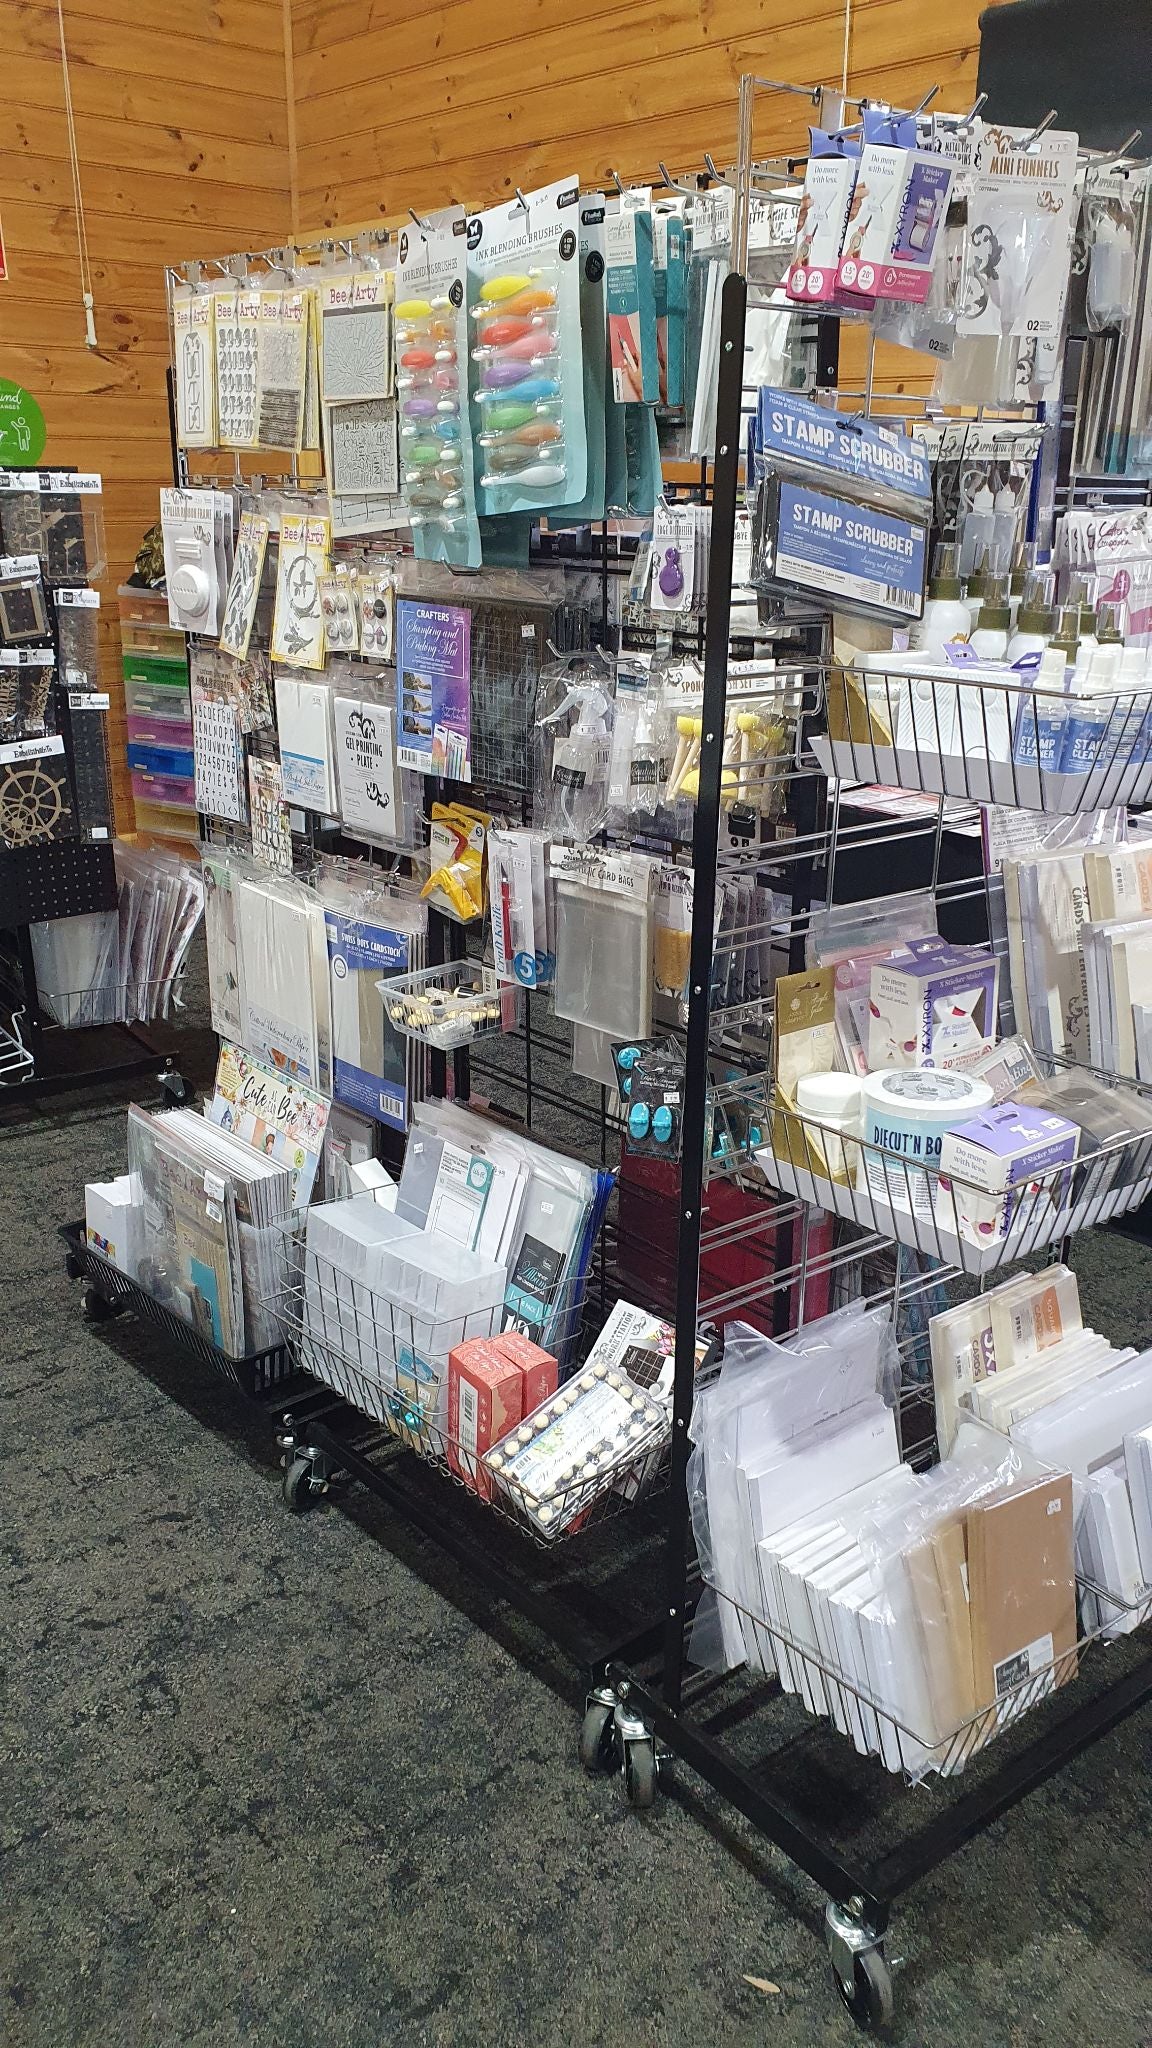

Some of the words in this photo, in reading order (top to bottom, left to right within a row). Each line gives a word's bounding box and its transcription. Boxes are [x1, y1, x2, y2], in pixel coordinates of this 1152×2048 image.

[962, 142, 972, 153] TIPS
[868, 164, 882, 174] with
[871, 154, 880, 162] Do
[880, 157, 897, 166] more
[990, 156, 1014, 175] MINI
[1016, 158, 1060, 178] FUNNELS
[814, 166, 823, 174] Do
[823, 166, 839, 174] more
[812, 176, 826, 184] with
[791, 206, 800, 218] SE
[475, 250, 488, 262] INK
[490, 235, 526, 257] BLENDING
[528, 222, 563, 244] BRUSHES
[608, 231, 632, 243] CRAFT
[402, 270, 410, 282] INK
[434, 258, 458, 274] BRUSHES
[330, 288, 347, 304] Bee
[355, 286, 378, 302] Arty
[177, 310, 188, 326] Bee
[192, 307, 208, 325] Arty
[218, 304, 232, 318] Bee
[240, 302, 260, 320] Arty
[264, 303, 276, 318] Bee
[284, 303, 304, 322] Arty
[1027, 320, 1040, 330] 02
[929, 338, 940, 351] 02
[772, 412, 834, 449] STAMP
[840, 436, 924, 482] SCRUBBER
[284, 527, 299, 540] Bee
[306, 530, 324, 545] Arty
[657, 525, 668, 534] EDGE
[792, 503, 842, 533] STAMP
[845, 520, 913, 556] SCRUBBER
[416, 609, 450, 622] CRAFTERS
[406, 618, 442, 640] Stamping
[442, 627, 459, 639] and
[438, 640, 459, 657] Mat
[346, 736, 355, 751] GEL
[356, 738, 382, 758] PRINTING
[1021, 736, 1056, 747] STAMP
[356, 754, 372, 770] PLATE
[618, 874, 634, 888] BAGS
[1072, 887, 1084, 926] CARDS
[492, 906, 501, 939] Knife
[342, 932, 356, 944] SWISS
[356, 938, 369, 948] DOTS
[370, 942, 400, 958] CARDSTOCK
[496, 940, 504, 973] Craft
[520, 954, 533, 976] 5
[882, 974, 890, 982] Do
[890, 977, 908, 988] more
[944, 976, 965, 986] Sticker
[966, 971, 984, 981] Maker
[880, 984, 894, 993] with
[922, 989, 932, 1036] XYRON
[244, 1076, 268, 1107] Cute
[276, 1094, 298, 1126] Bee
[874, 1126, 922, 1154] DIECUT'N
[926, 1136, 943, 1156] BO
[954, 1156, 970, 1168] with
[956, 1146, 967, 1156] Do
[967, 1150, 988, 1164] more
[618, 1312, 634, 1340] STATION
[971, 1340, 981, 1377] CARDS
